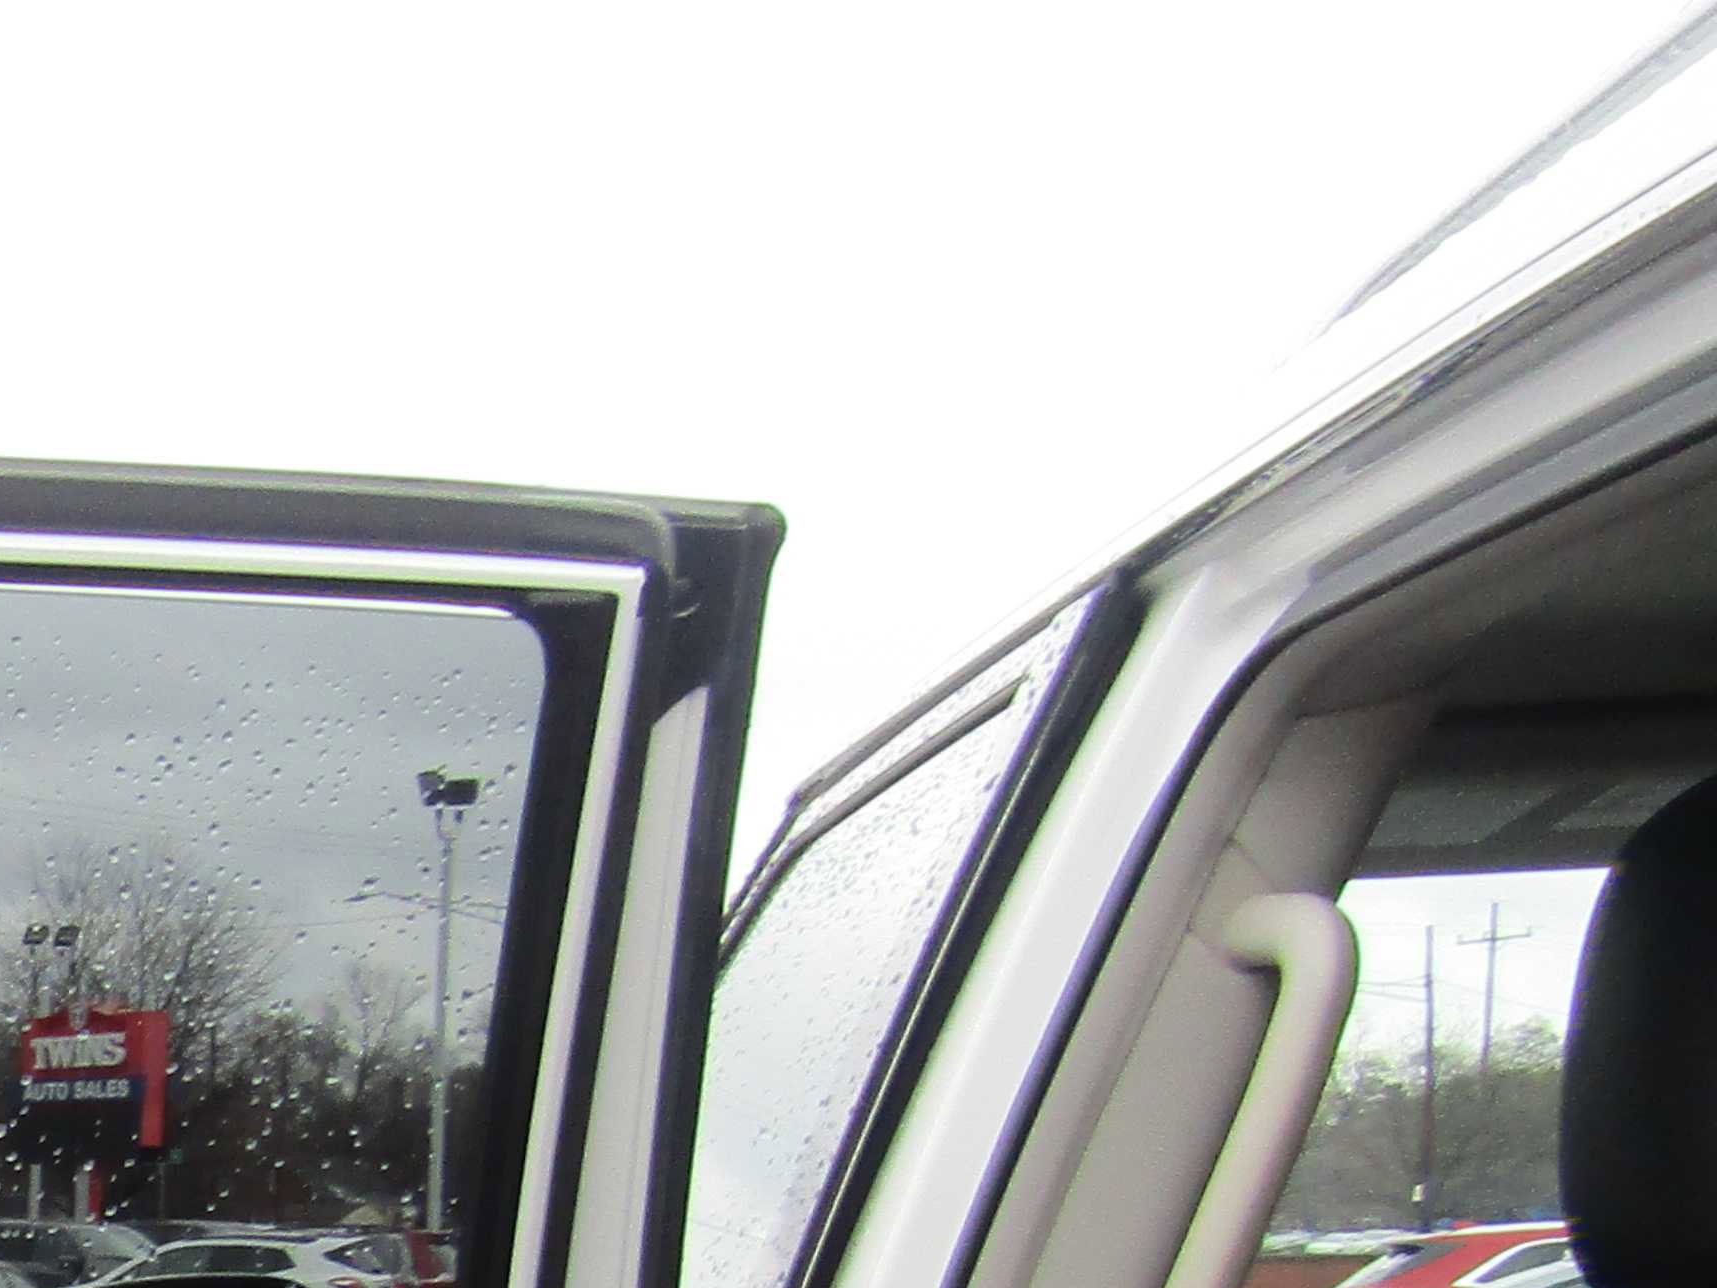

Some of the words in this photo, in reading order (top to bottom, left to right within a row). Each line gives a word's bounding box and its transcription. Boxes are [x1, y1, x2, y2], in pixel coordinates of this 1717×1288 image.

[30, 1031, 127, 1070] TWINS
[22, 1081, 68, 1101] AUTO
[73, 1079, 131, 1099] SALES
